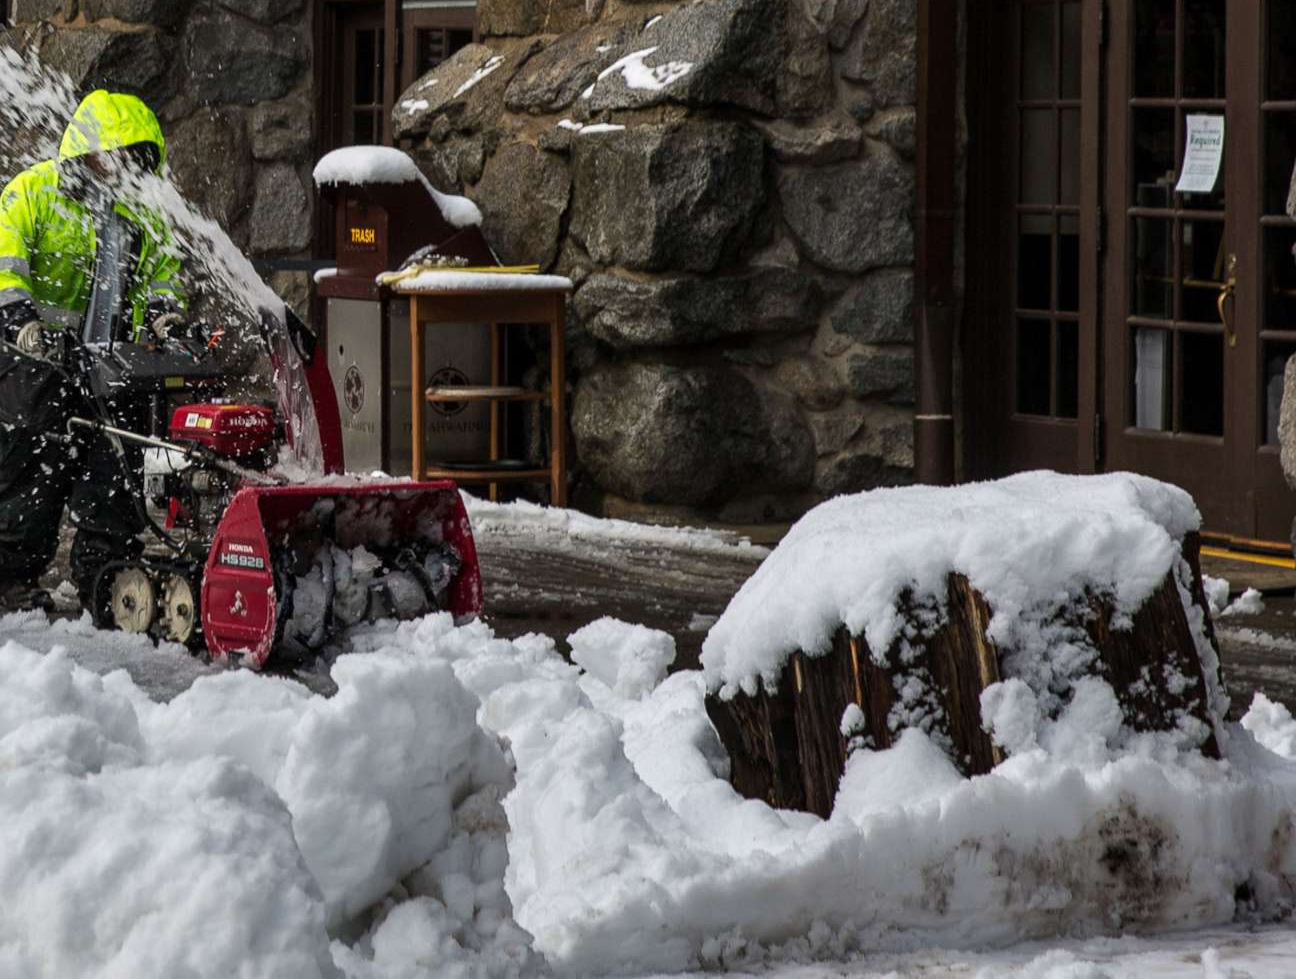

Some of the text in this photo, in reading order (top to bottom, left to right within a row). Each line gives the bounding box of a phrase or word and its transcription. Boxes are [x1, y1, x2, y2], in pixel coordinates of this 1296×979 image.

[351, 228, 375, 242] TRASH
[229, 543, 254, 554] HONDA
[221, 552, 264, 569] HS928
